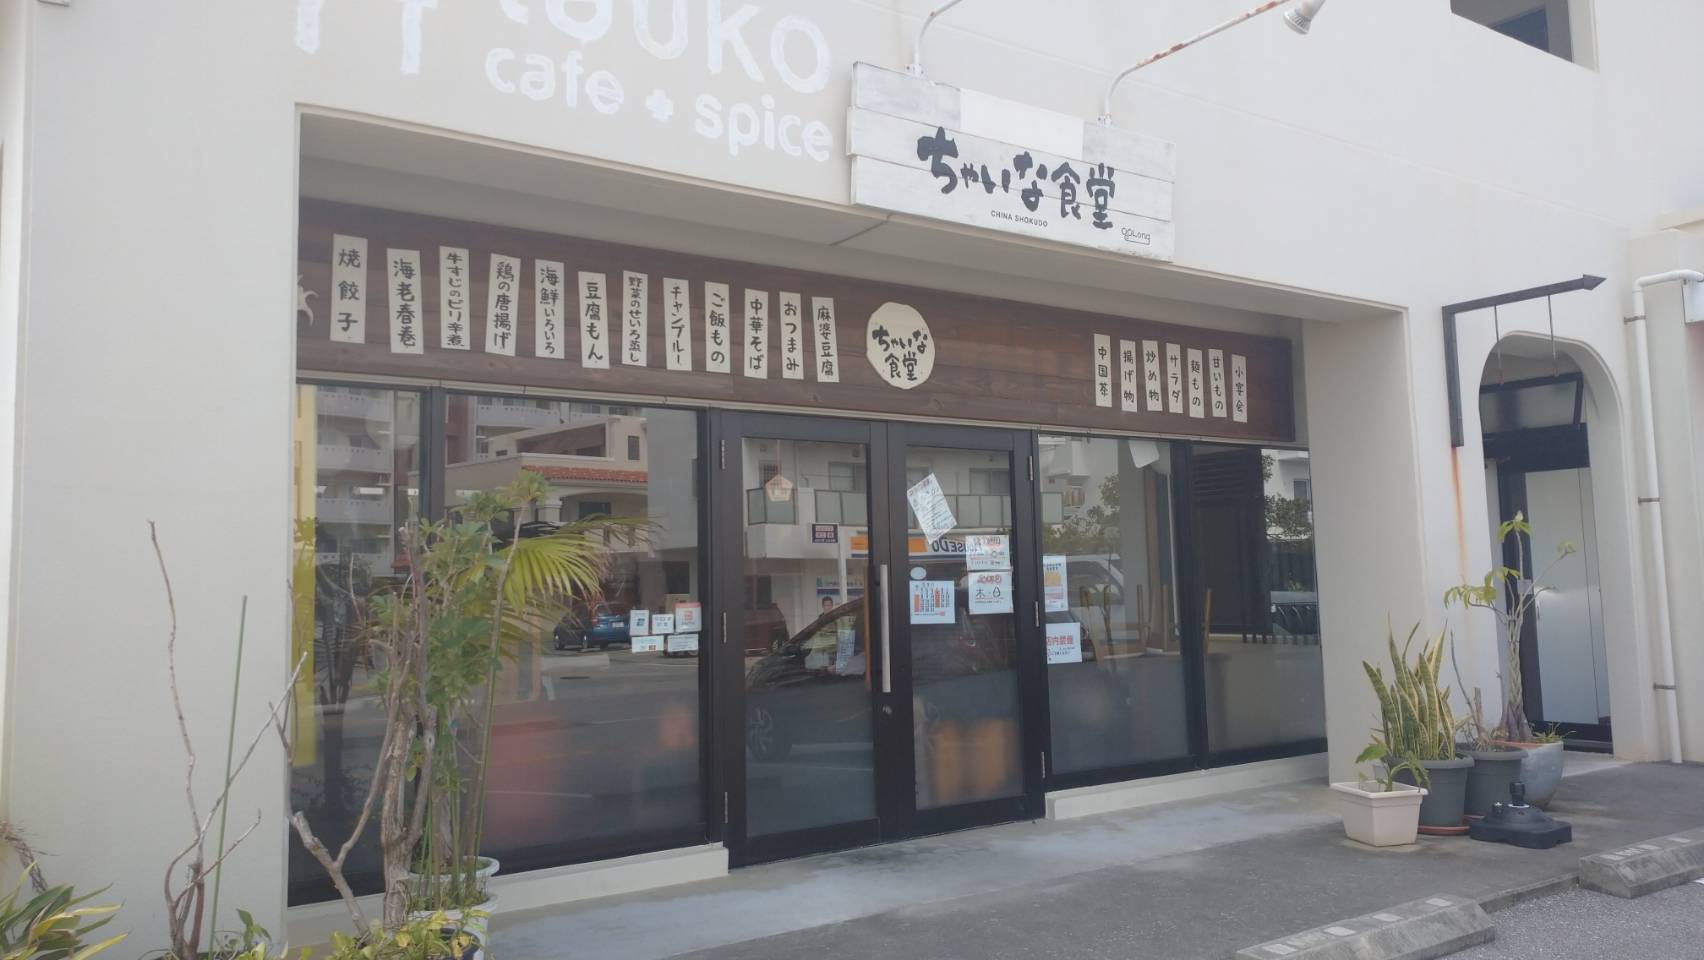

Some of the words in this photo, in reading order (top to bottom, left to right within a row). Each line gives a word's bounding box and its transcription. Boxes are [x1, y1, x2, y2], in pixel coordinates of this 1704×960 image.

[485, 48, 624, 114] cafe
[695, 94, 834, 162] spice
[917, 127, 1116, 230] ちゃいな食堂
[990, 210, 1013, 221] CHINA
[1014, 214, 1049, 228] SHOKUDO
[337, 248, 361, 332] 焼餃子
[393, 258, 416, 348] 海老春巻
[493, 261, 515, 349] 鶏の唐揚げ
[540, 265, 560, 354] 海鮮いろいろ
[585, 281, 603, 360] 豆腐もん
[628, 276, 642, 362] 野菜のせいろ蒸し
[671, 286, 685, 364] チャンプルー
[709, 292, 726, 364] ご飯もの
[749, 299, 764, 370] 中華そば
[784, 301, 799, 374] おつまみ
[817, 305, 834, 376] 麻婆豆腐
[872, 325, 928, 354] ちゃいな
[885, 350, 918, 381] 食堂
[1098, 346, 1109, 397] 中国茶
[1122, 351, 1135, 403] 揚げ物
[1146, 351, 1160, 402] 炒め物
[1170, 355, 1181, 401] サラダ
[1212, 356, 1224, 410] 甘いもの
